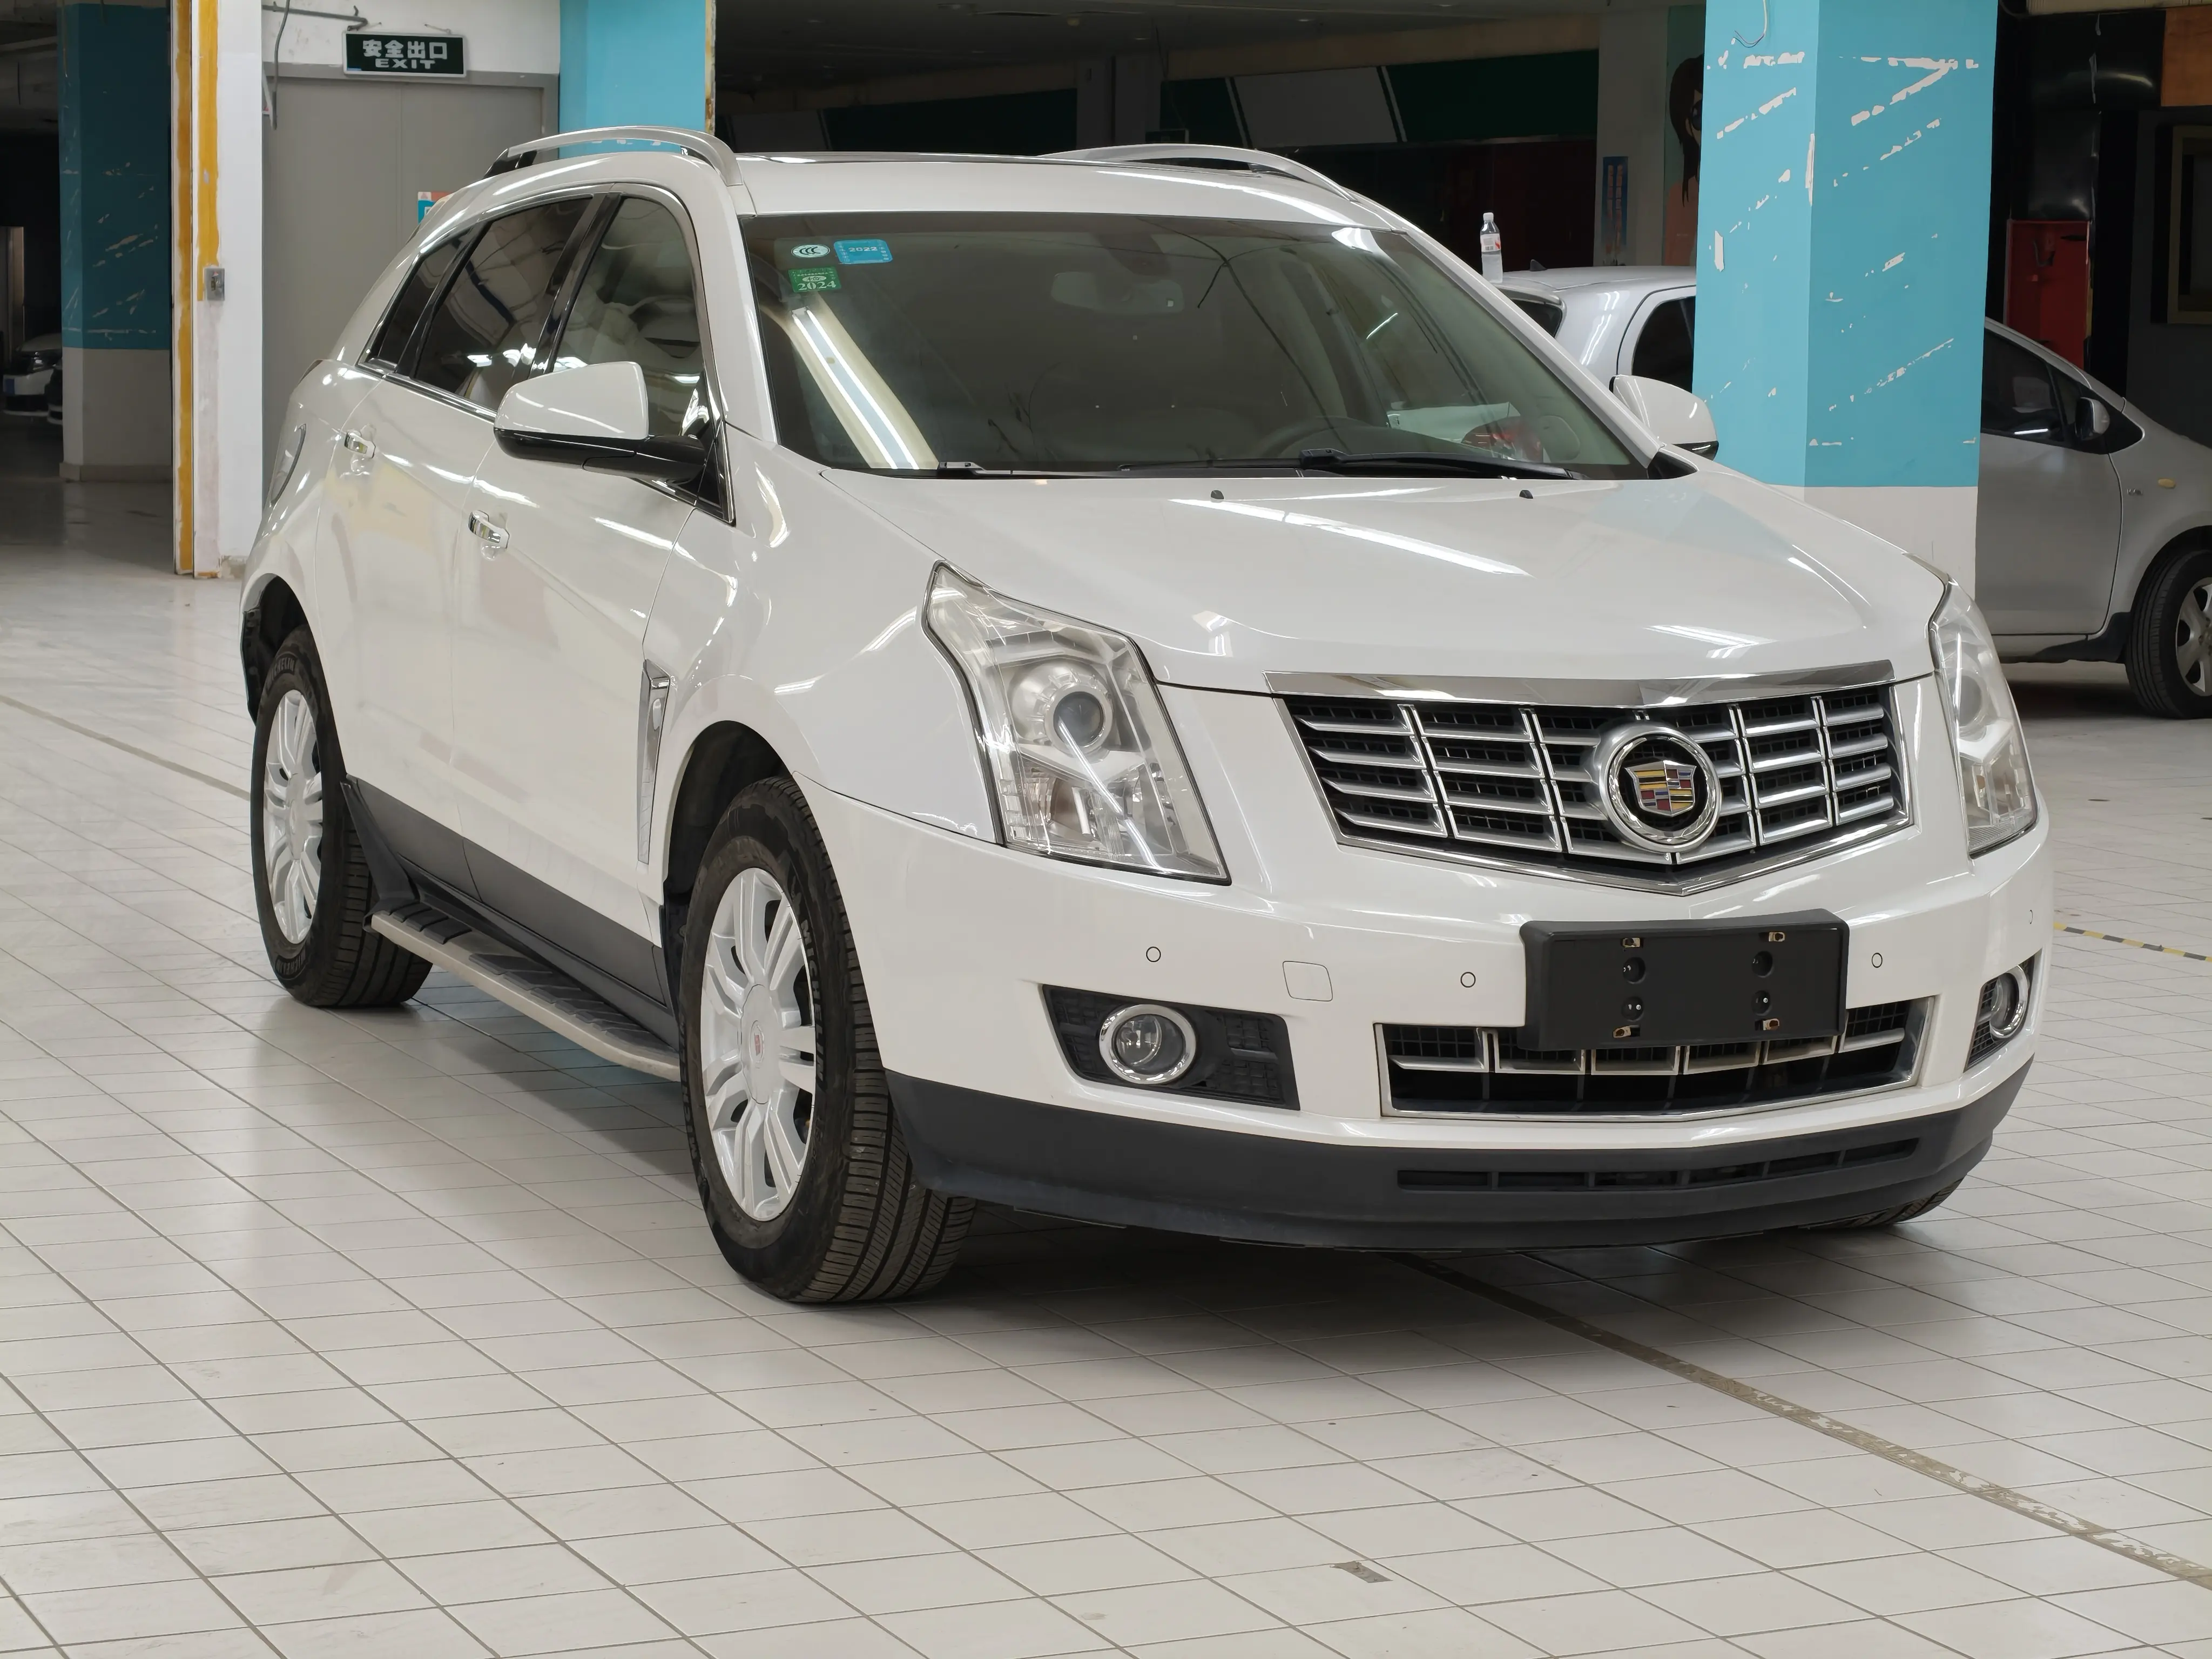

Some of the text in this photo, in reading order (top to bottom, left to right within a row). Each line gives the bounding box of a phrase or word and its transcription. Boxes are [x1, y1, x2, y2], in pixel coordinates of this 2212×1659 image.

[362, 39, 447, 59] 安全出口
[375, 58, 435, 69] EXIT
[797, 280, 837, 291] 2024
[801, 919, 824, 1081] MICHELIN
